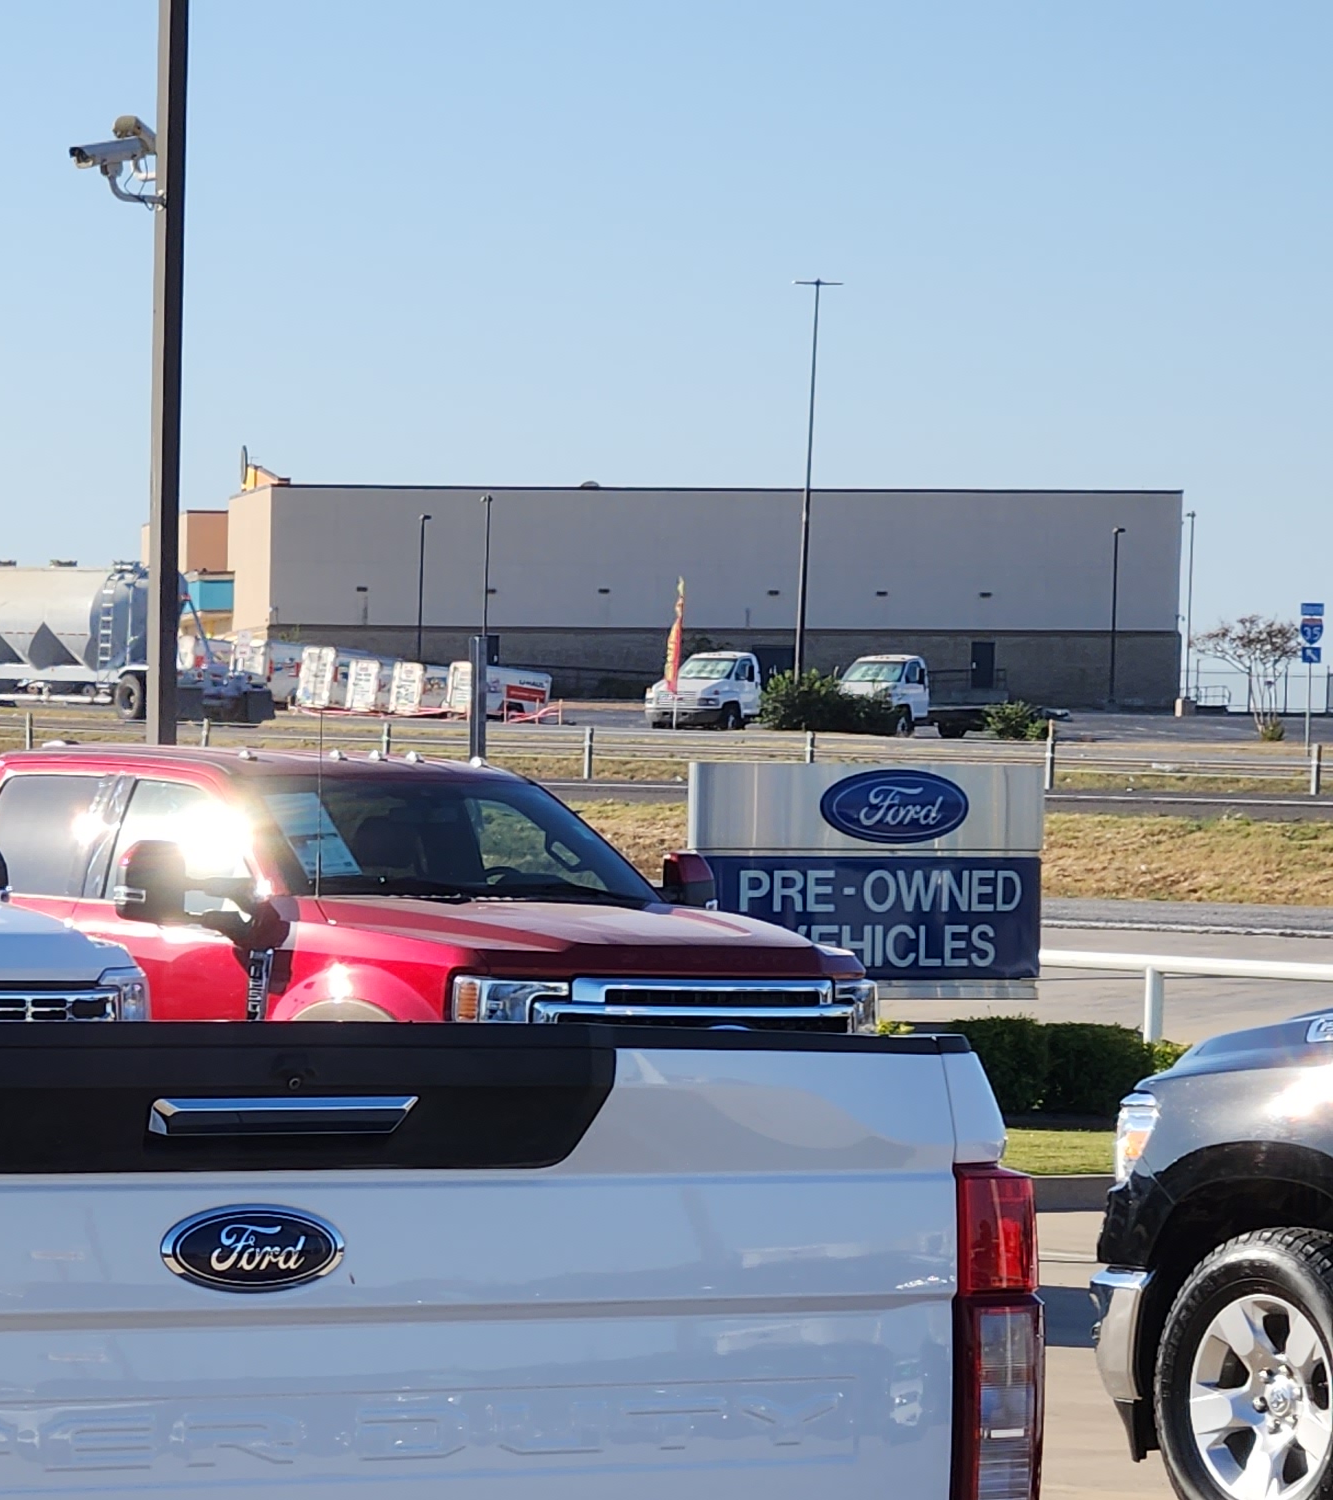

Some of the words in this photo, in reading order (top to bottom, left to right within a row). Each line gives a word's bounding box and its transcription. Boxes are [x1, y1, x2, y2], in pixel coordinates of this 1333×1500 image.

[1303, 626, 1321, 640] 35
[858, 785, 944, 827] Ford
[739, 869, 1023, 913] PRE-OWNED
[209, 1223, 307, 1272] Ford
